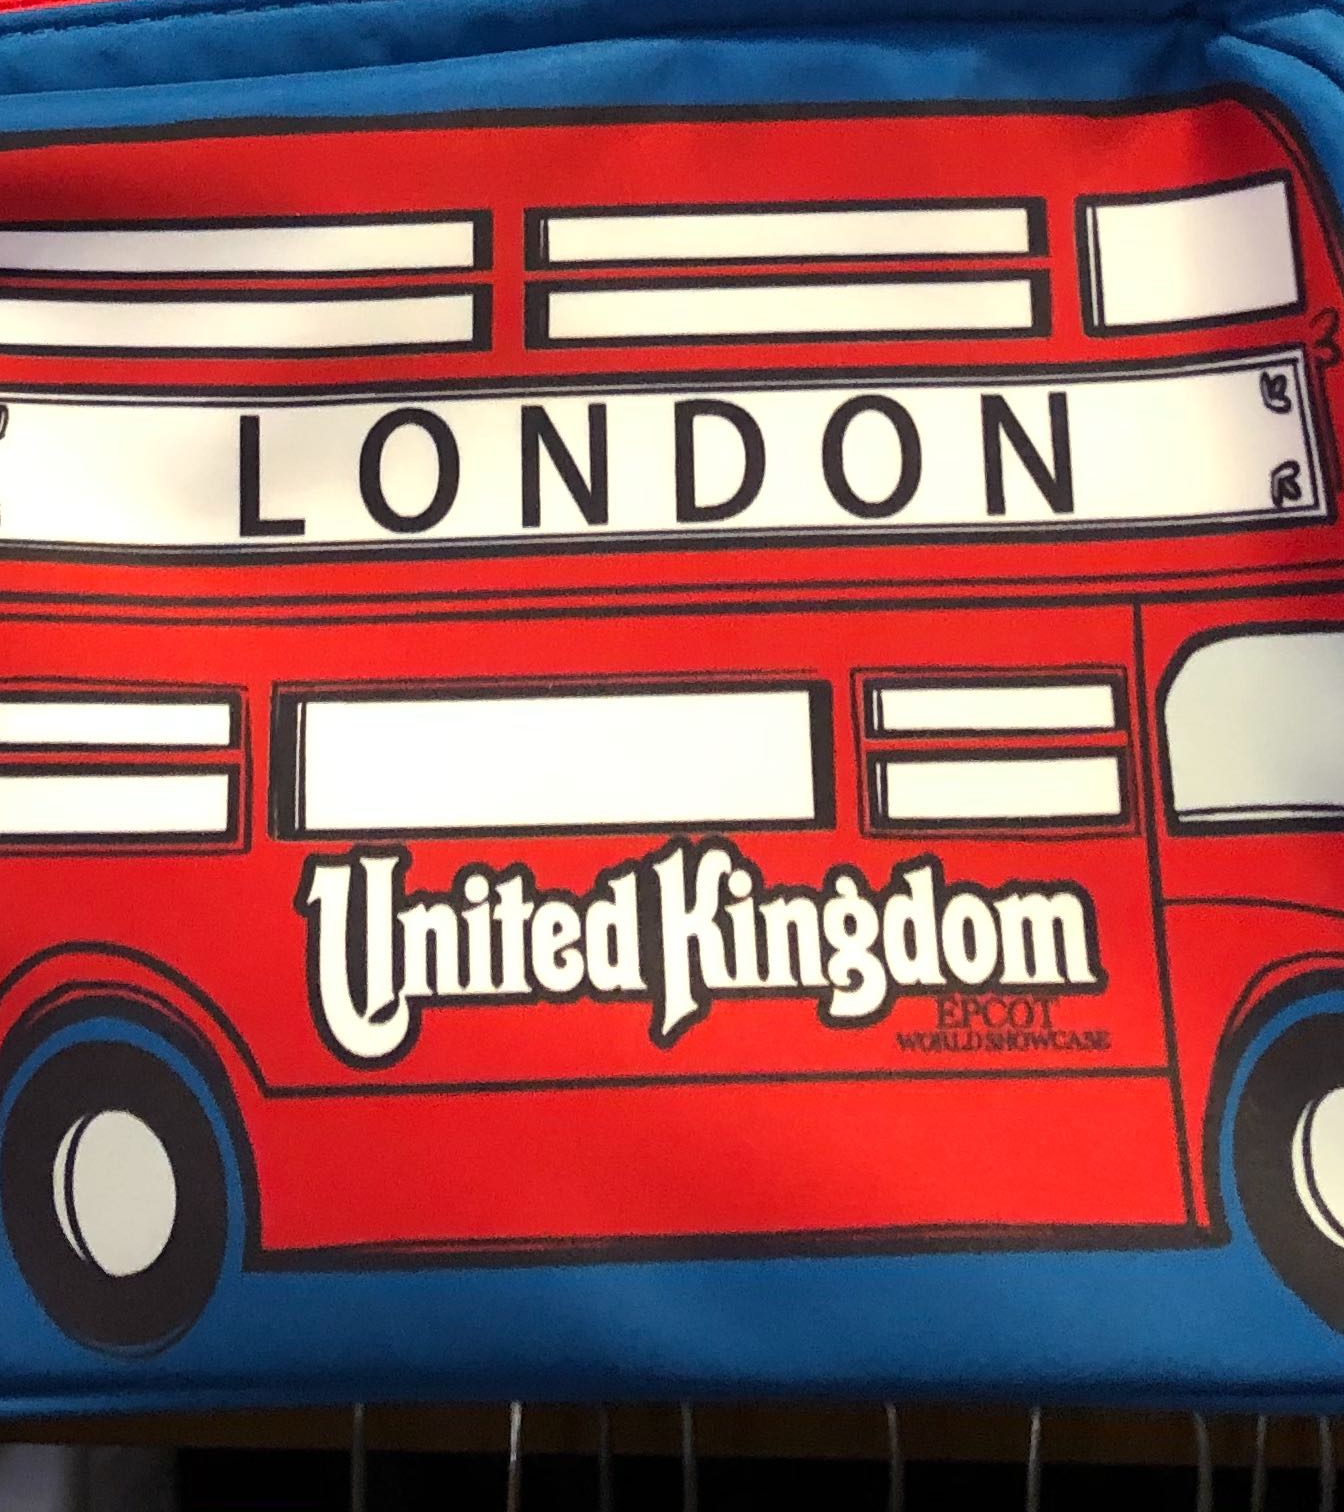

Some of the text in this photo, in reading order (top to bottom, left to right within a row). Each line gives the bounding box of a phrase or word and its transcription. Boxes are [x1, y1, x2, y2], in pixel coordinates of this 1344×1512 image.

[236, 388, 1078, 538] LONDON
[305, 846, 1098, 1061] United Kingdom
[896, 1029, 1111, 1052] WORLD SHOWCASE
[936, 995, 1059, 1029] EPCOT
